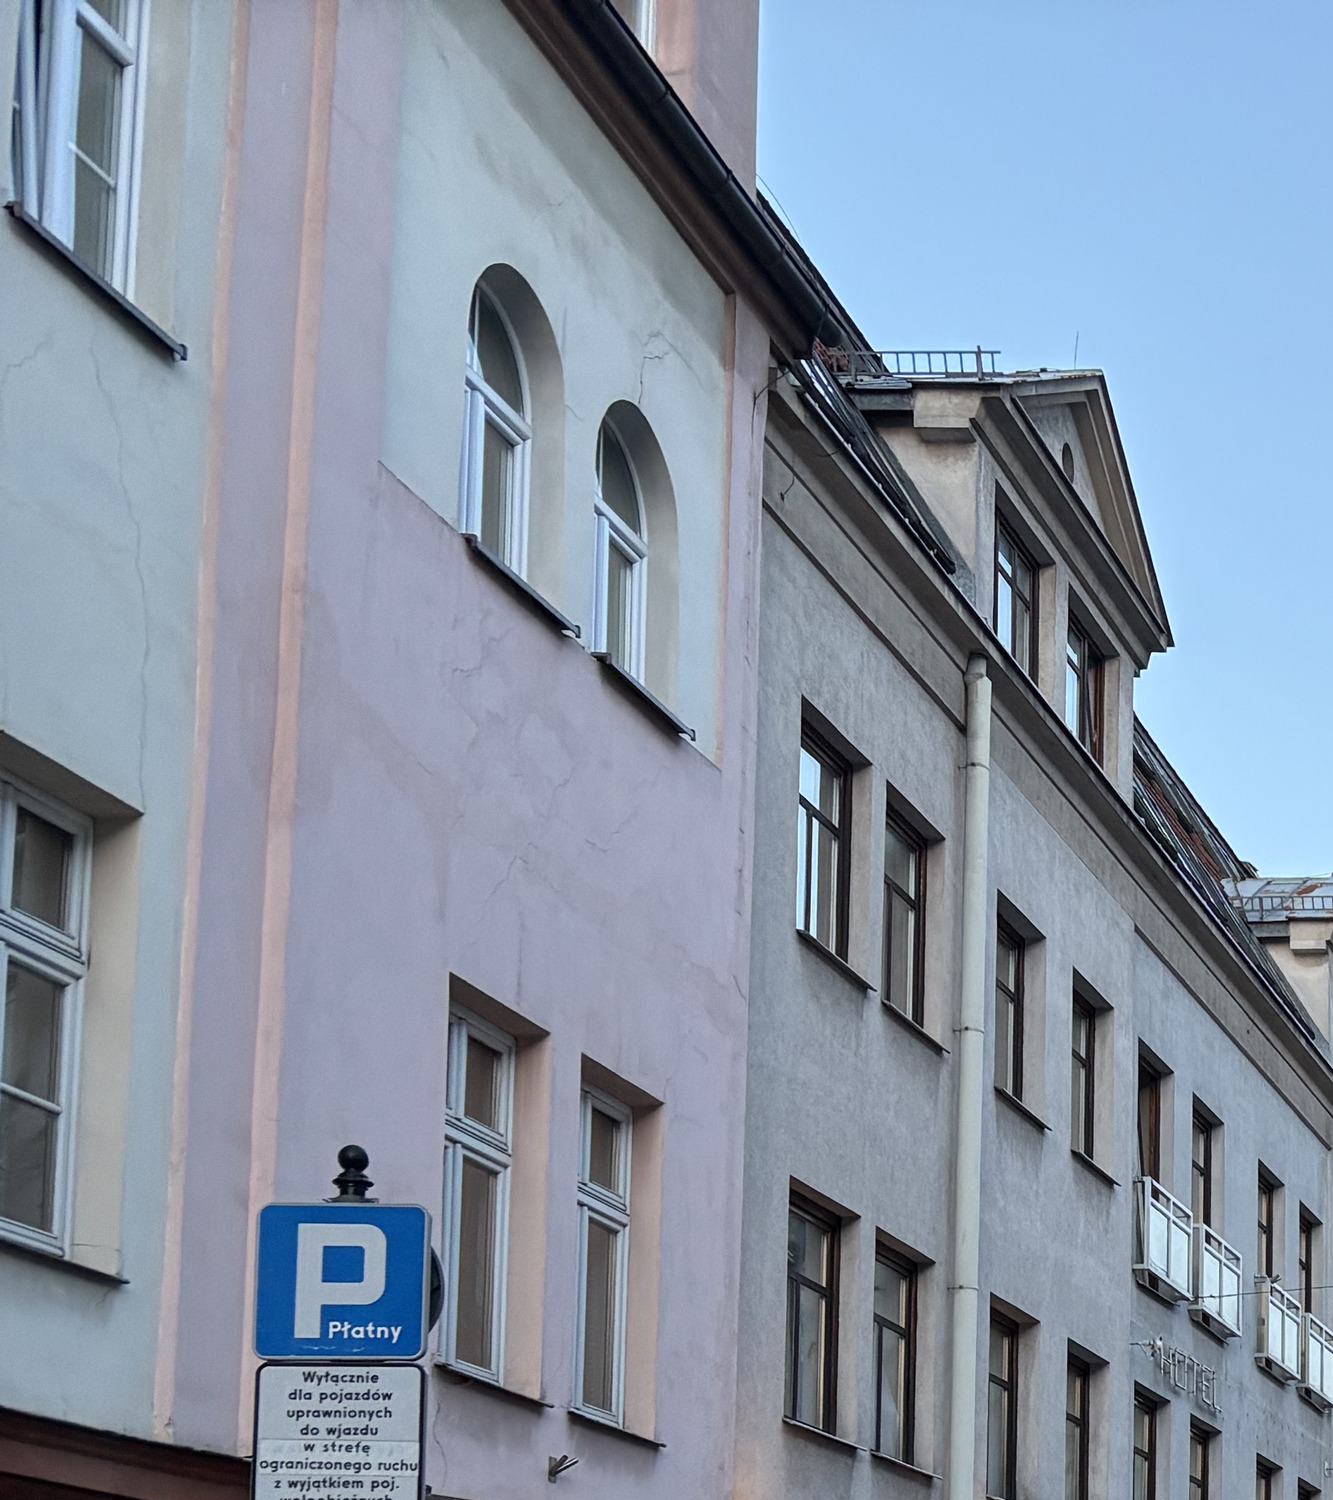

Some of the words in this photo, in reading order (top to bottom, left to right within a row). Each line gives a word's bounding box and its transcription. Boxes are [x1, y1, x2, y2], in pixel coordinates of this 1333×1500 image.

[293, 1222, 387, 1339] P
[329, 1321, 402, 1343] Płatny
[302, 1371, 379, 1386] Wyłącznie
[1160, 1341, 1223, 1412] HOTEL
[288, 1388, 312, 1401] dla
[319, 1388, 393, 1403] pojazdów
[286, 1406, 392, 1421] uprawnionych
[300, 1424, 320, 1436] do
[325, 1424, 378, 1439] wjazdu
[303, 1443, 315, 1452] w
[322, 1441, 371, 1457] strefę
[259, 1457, 372, 1474] ograniczonego
[377, 1459, 418, 1472] ruchu
[274, 1479, 281, 1489] z
[287, 1476, 364, 1492] wyjątkiem
[371, 1476, 400, 1492] poj.
